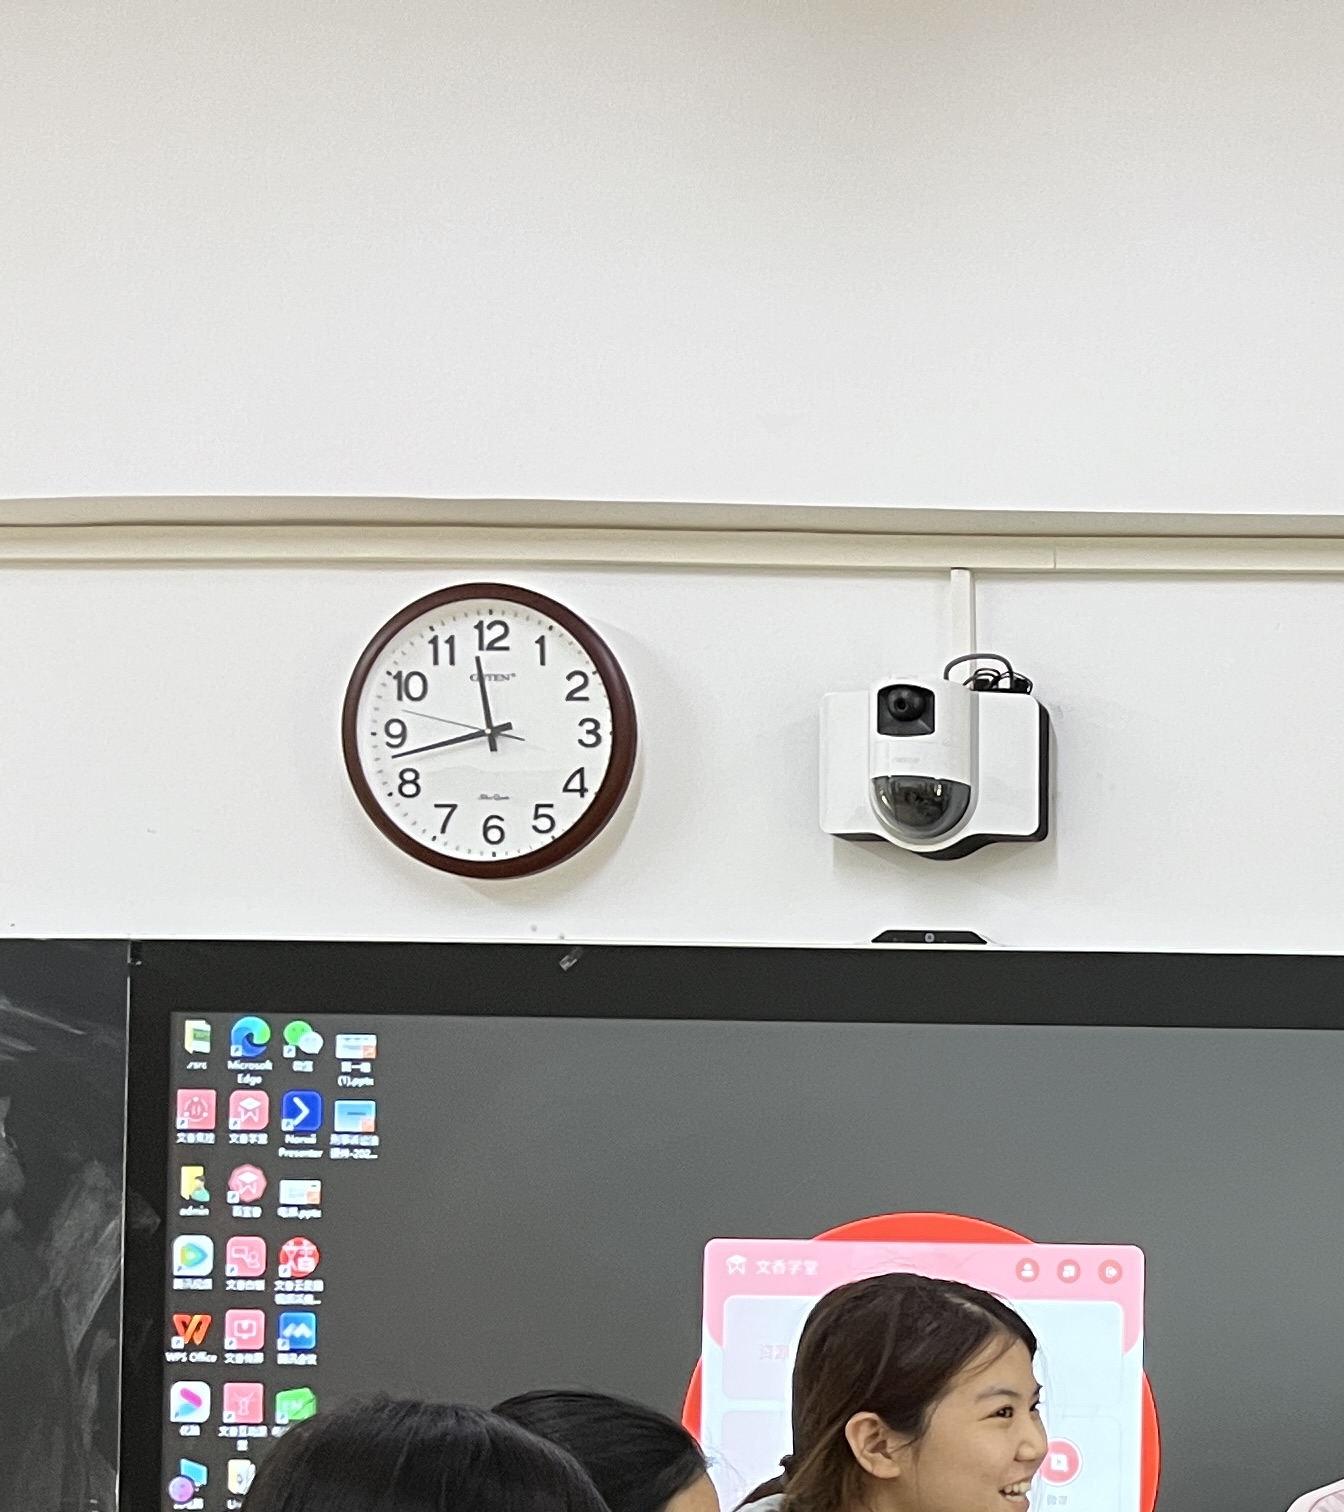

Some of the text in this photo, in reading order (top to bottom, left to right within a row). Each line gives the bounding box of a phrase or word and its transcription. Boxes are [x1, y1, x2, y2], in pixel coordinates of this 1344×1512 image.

[428, 635, 455, 665] 11
[474, 620, 510, 651] 12
[535, 635, 546, 665] 1
[393, 670, 428, 701] 10
[565, 670, 590, 701] 2
[384, 718, 407, 748] 9
[577, 718, 601, 748] 3
[398, 768, 421, 797] 8
[562, 767, 588, 797] 4
[434, 804, 458, 834] 7
[483, 815, 505, 844] 6
[532, 804, 556, 833] 5
